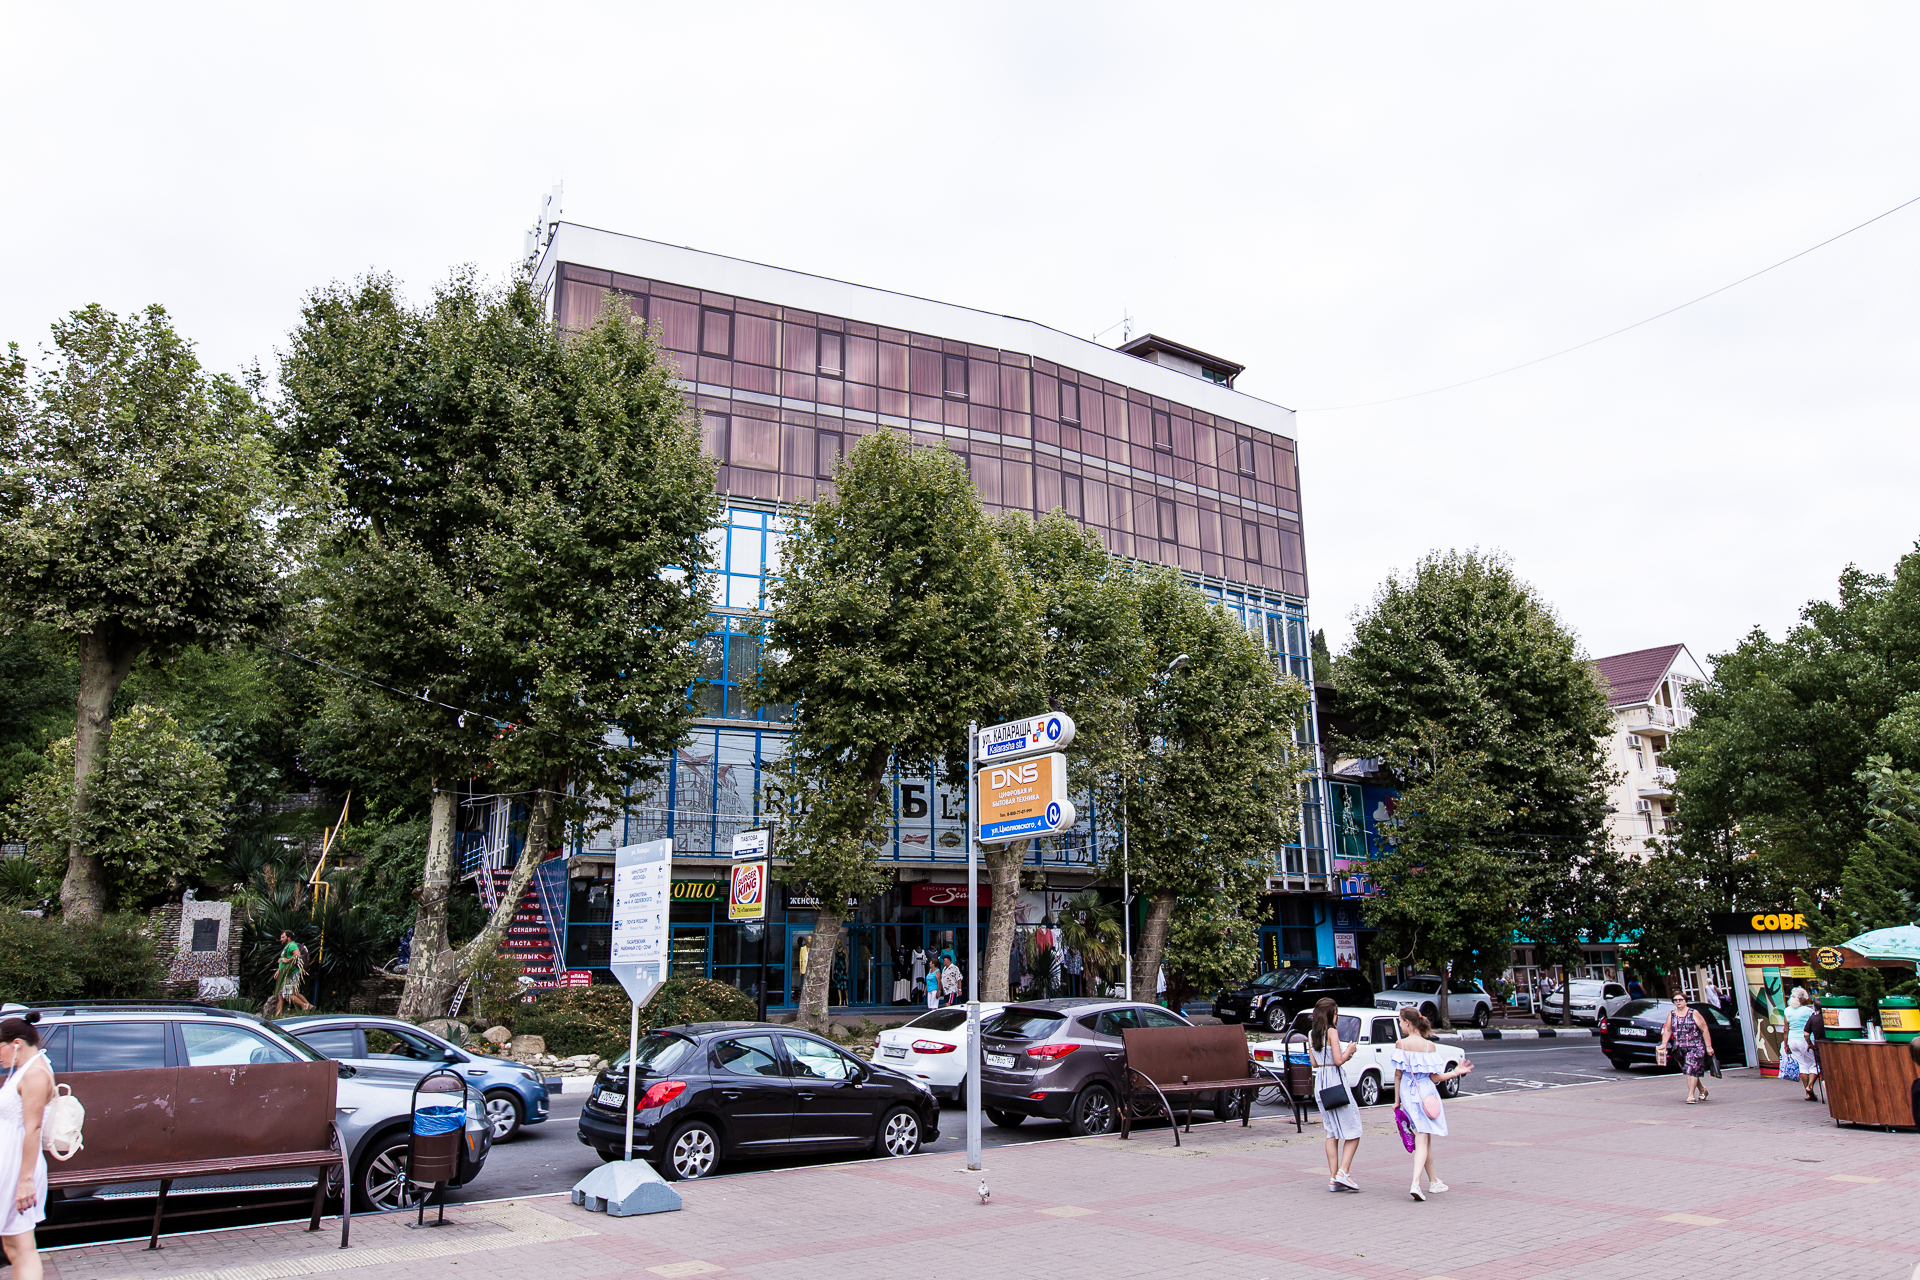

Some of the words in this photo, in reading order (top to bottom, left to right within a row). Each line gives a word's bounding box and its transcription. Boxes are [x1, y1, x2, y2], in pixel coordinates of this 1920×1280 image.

[982, 735, 992, 748] ул.
[993, 722, 1032, 743] КАЛАРАША
[989, 741, 1015, 755] Kalarasha
[1015, 739, 1024, 750] str.
[991, 762, 1039, 790] DNS
[992, 798, 1016, 808] БЫТОВАЯ
[1016, 793, 1040, 804] ТЕХНИКА
[998, 787, 1027, 799] ЦИФРОВАЯ
[1027, 786, 1033, 794] И
[1037, 819, 1042, 827] 4
[737, 869, 757, 888] BURGER
[737, 877, 757, 898] KING
[789, 897, 824, 905] ЖЕНСКА
